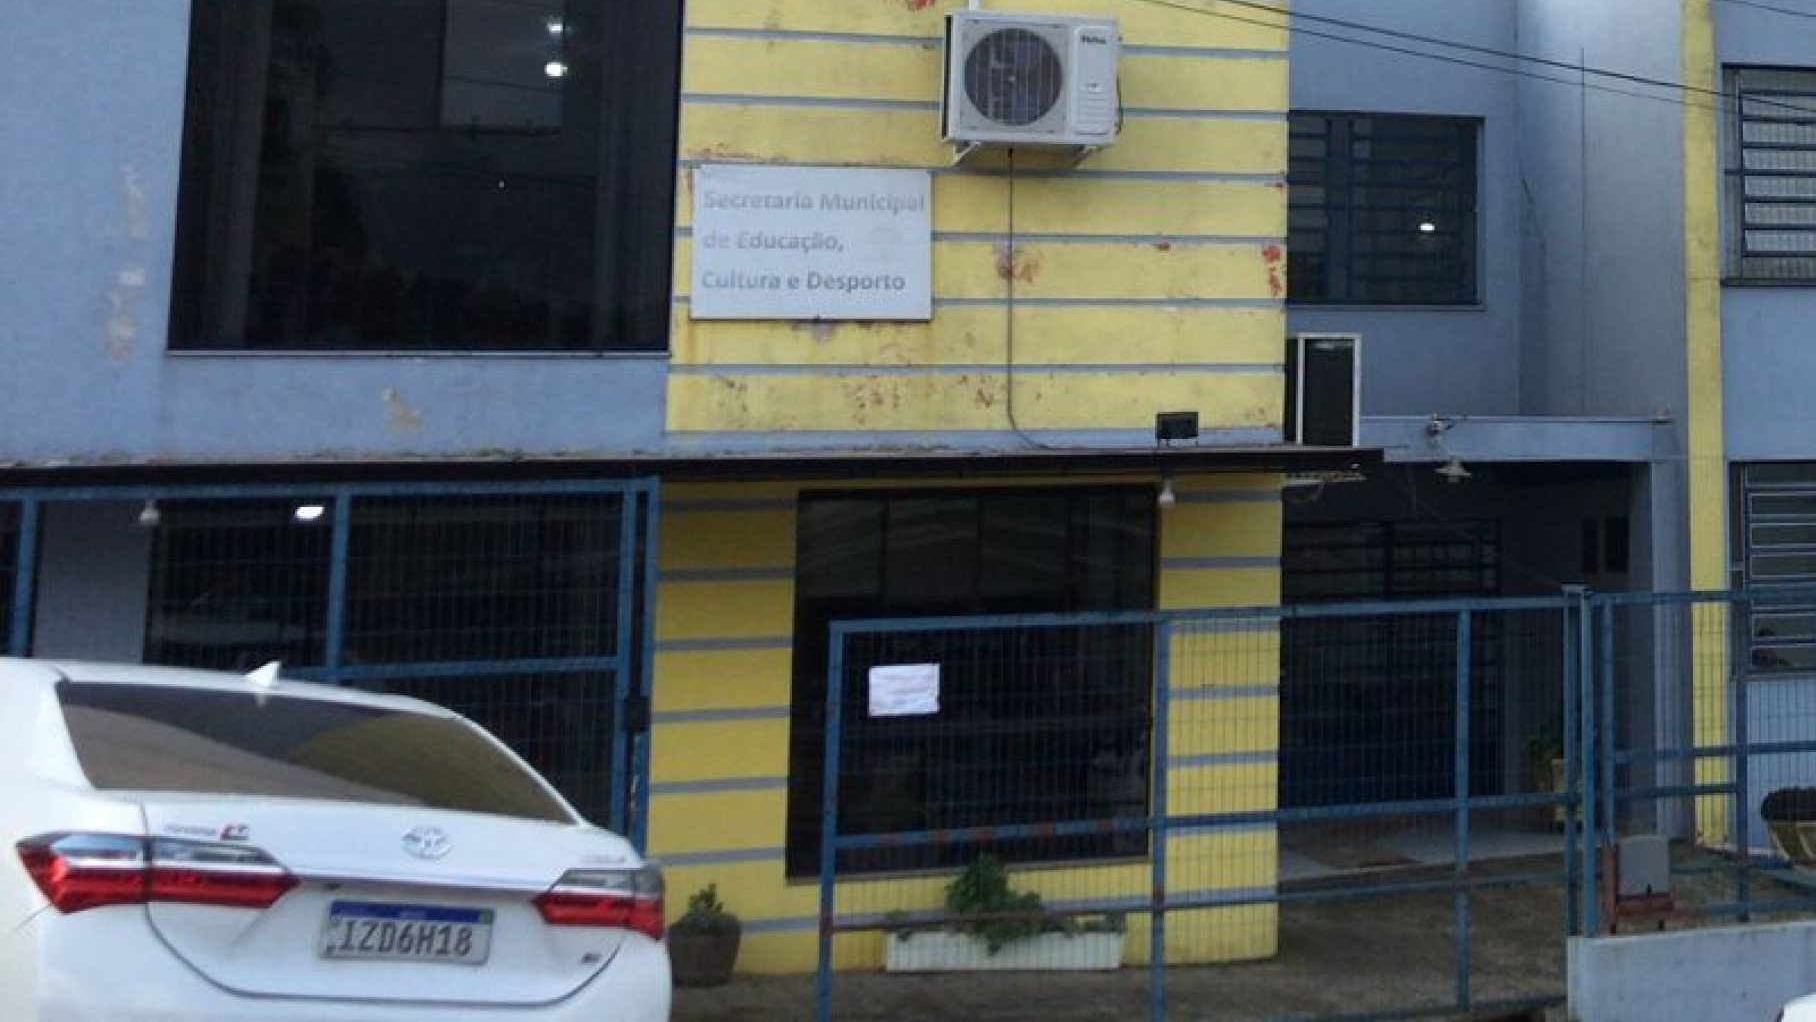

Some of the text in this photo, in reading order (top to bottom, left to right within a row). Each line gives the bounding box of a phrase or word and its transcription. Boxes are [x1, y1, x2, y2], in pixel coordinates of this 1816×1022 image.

[703, 190, 925, 215] Secretaria Municipal
[703, 229, 844, 254] de Educação,
[702, 270, 906, 293] Cultura e Desporto
[339, 919, 473, 957] IZD6H18
